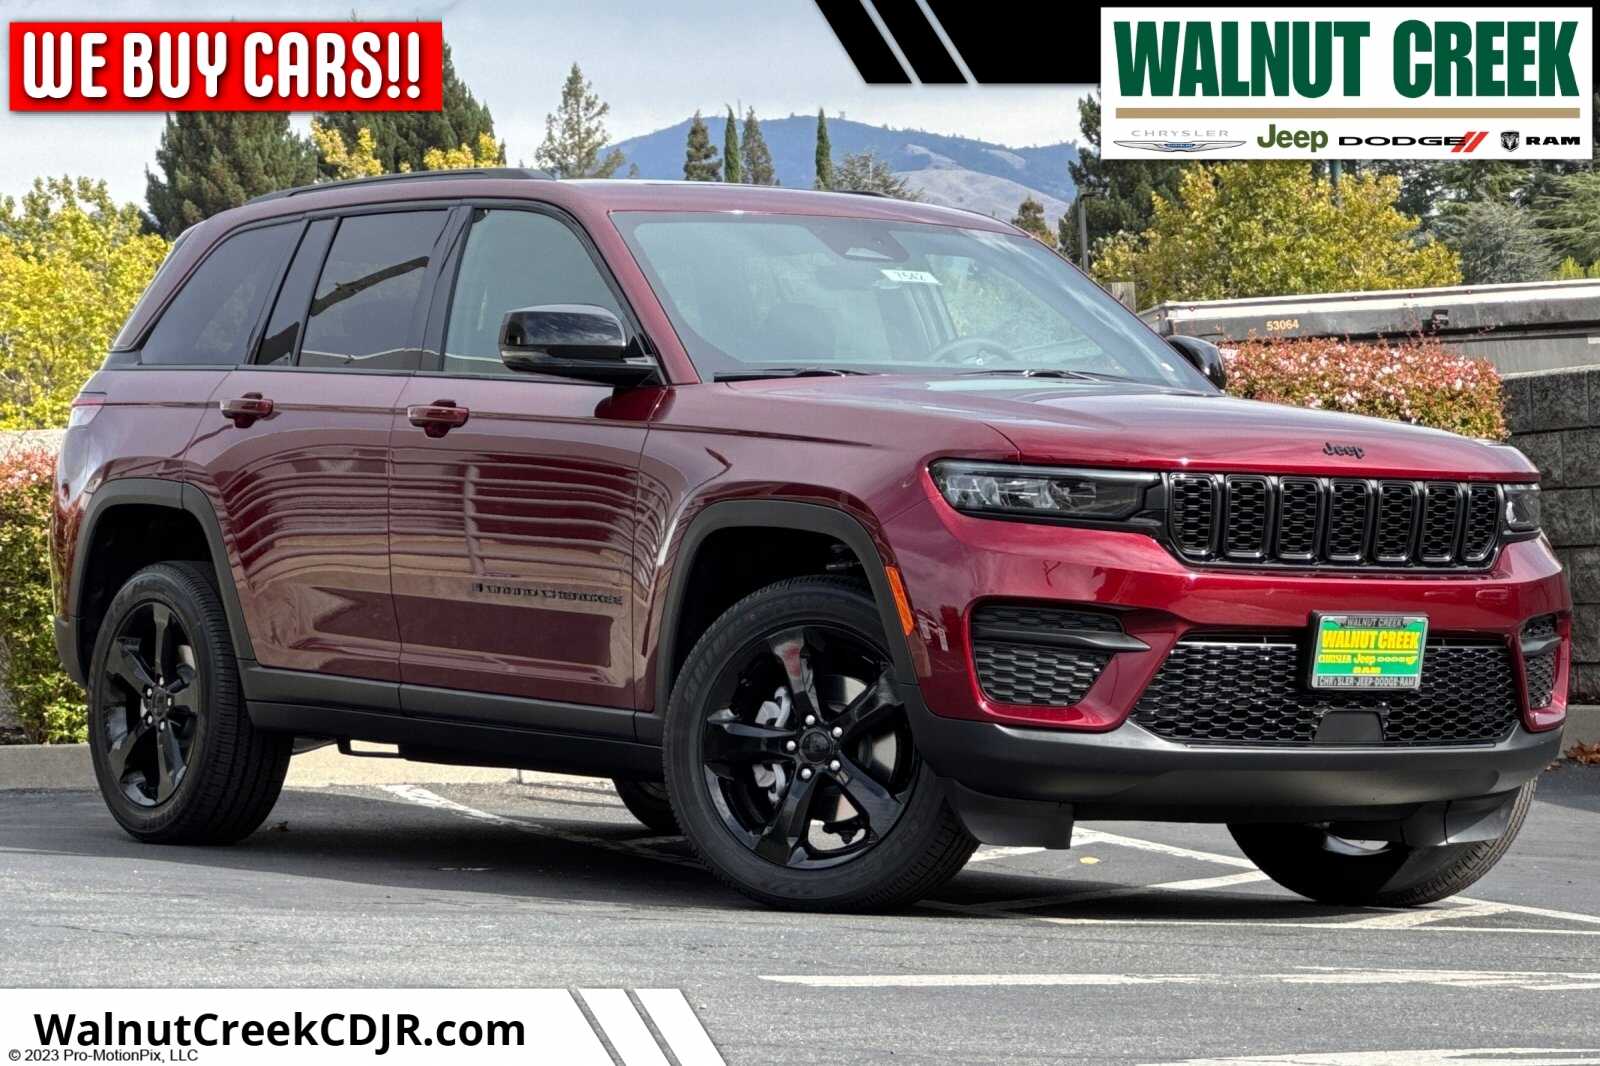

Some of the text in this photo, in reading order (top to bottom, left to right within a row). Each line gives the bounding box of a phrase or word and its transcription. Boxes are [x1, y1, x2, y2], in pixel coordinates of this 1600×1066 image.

[1266, 319, 1300, 331] 53064
[1322, 441, 1365, 460] Jeep
[1322, 629, 1421, 649] WALNUT CREEK
